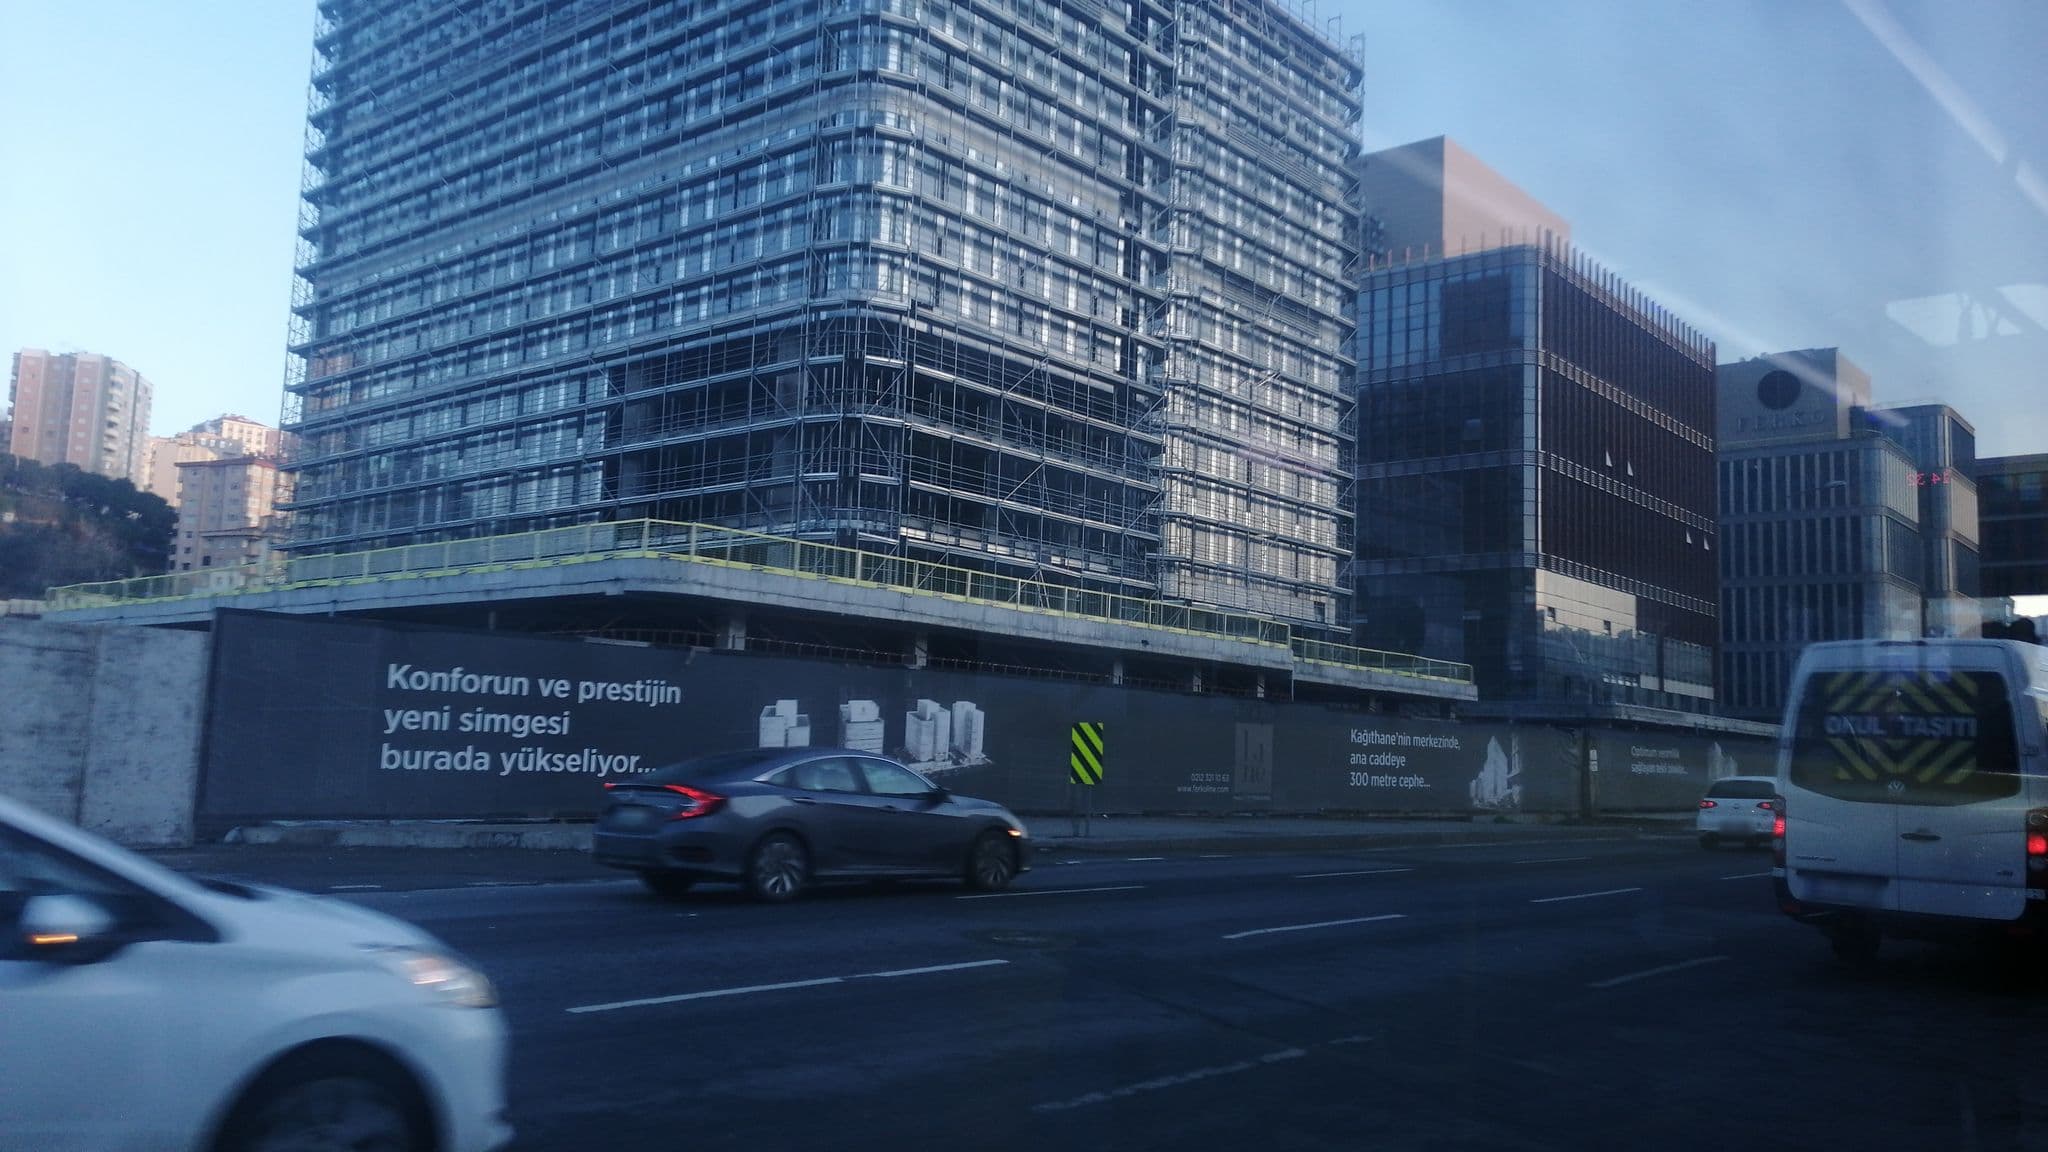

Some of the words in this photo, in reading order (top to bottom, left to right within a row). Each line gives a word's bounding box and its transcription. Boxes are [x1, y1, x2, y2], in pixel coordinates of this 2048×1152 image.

[387, 663, 529, 697] Konforun
[536, 677, 571, 699] ve
[578, 679, 681, 707] prestijin
[383, 705, 451, 734] yeni
[458, 707, 571, 738] simgesi
[1350, 728, 1411, 746] Kağıthane'nin
[380, 743, 490, 772] burada
[499, 747, 656, 778] yükseliyor...
[1350, 752, 1366, 765] ana
[1369, 752, 1406, 769] caddeye
[1349, 771, 1369, 787] 300
[1371, 773, 1397, 788] metre
